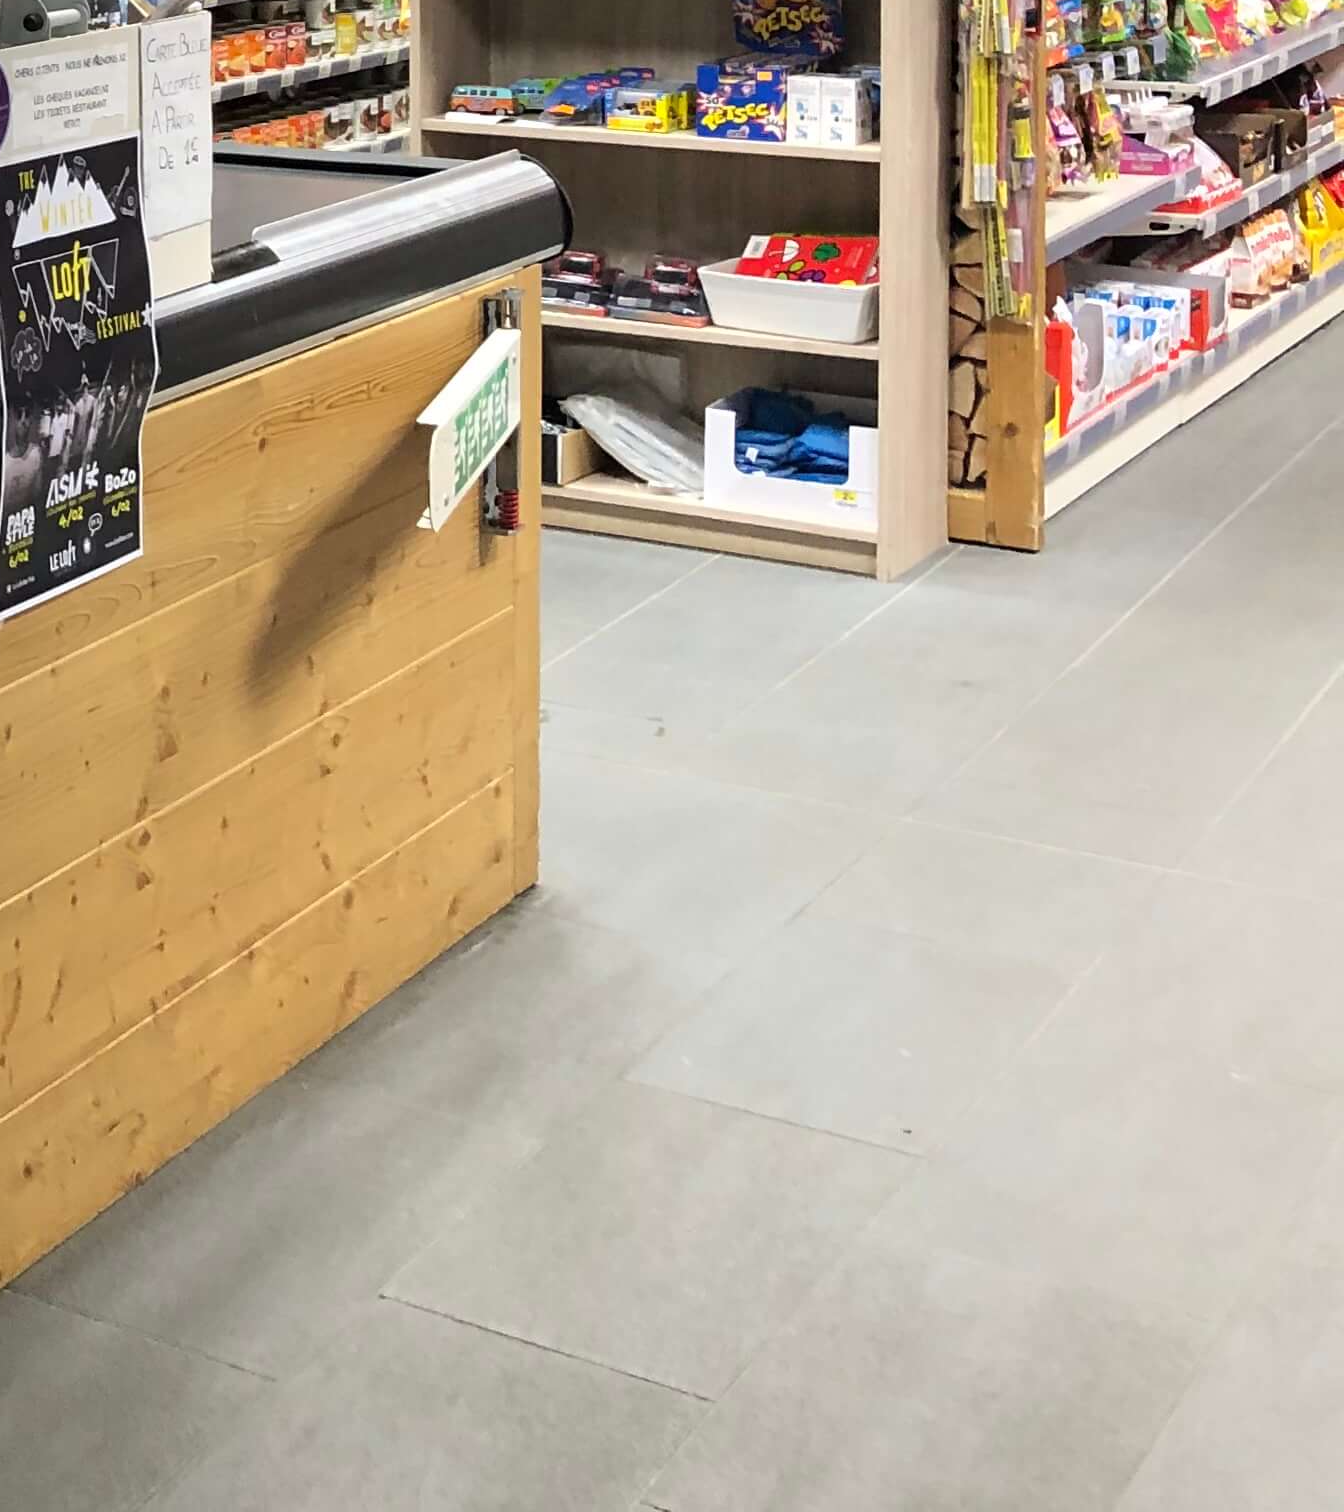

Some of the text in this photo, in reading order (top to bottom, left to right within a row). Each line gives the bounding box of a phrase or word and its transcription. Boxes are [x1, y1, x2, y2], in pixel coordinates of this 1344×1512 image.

[151, 109, 162, 135] A
[700, 102, 771, 131] PETSEC
[18, 168, 36, 192] THE
[39, 192, 95, 234] WINTER
[96, 309, 143, 341] FESTIVAL
[7, 505, 36, 531] PAPA
[4, 520, 35, 546] STYLE
[49, 552, 59, 572] LE
